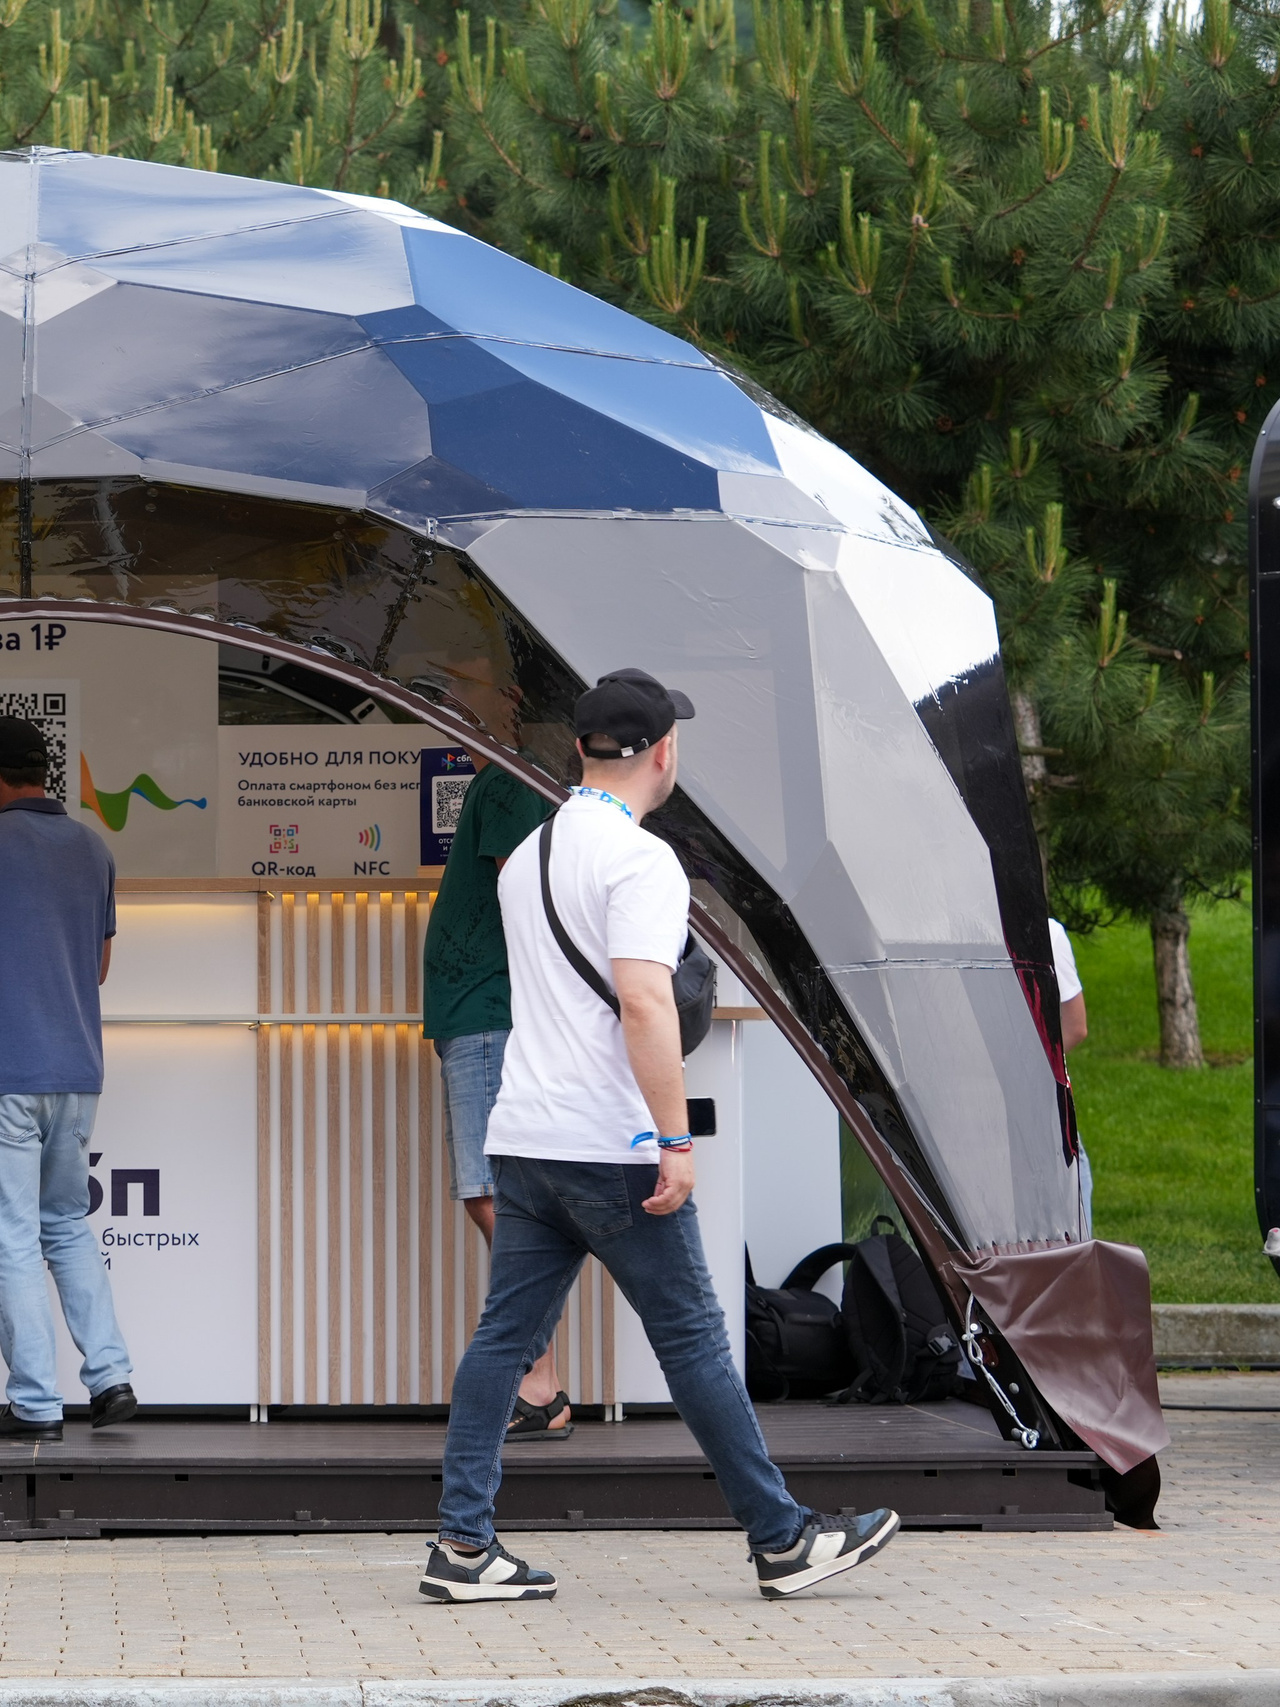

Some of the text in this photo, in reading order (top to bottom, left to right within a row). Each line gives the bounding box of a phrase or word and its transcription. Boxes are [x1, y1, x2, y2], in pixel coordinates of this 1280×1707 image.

[30, 623, 67, 651] 1₽
[238, 751, 319, 768] УДОБНО
[325, 751, 363, 767] ДЛЯ
[238, 780, 286, 791] Оплата
[289, 779, 371, 793] смартфоном
[374, 780, 397, 790] без
[238, 796, 357, 808] банковской карты
[251, 861, 316, 877] QR-код
[354, 861, 390, 875] NFC
[102, 1227, 199, 1251] быстрых
